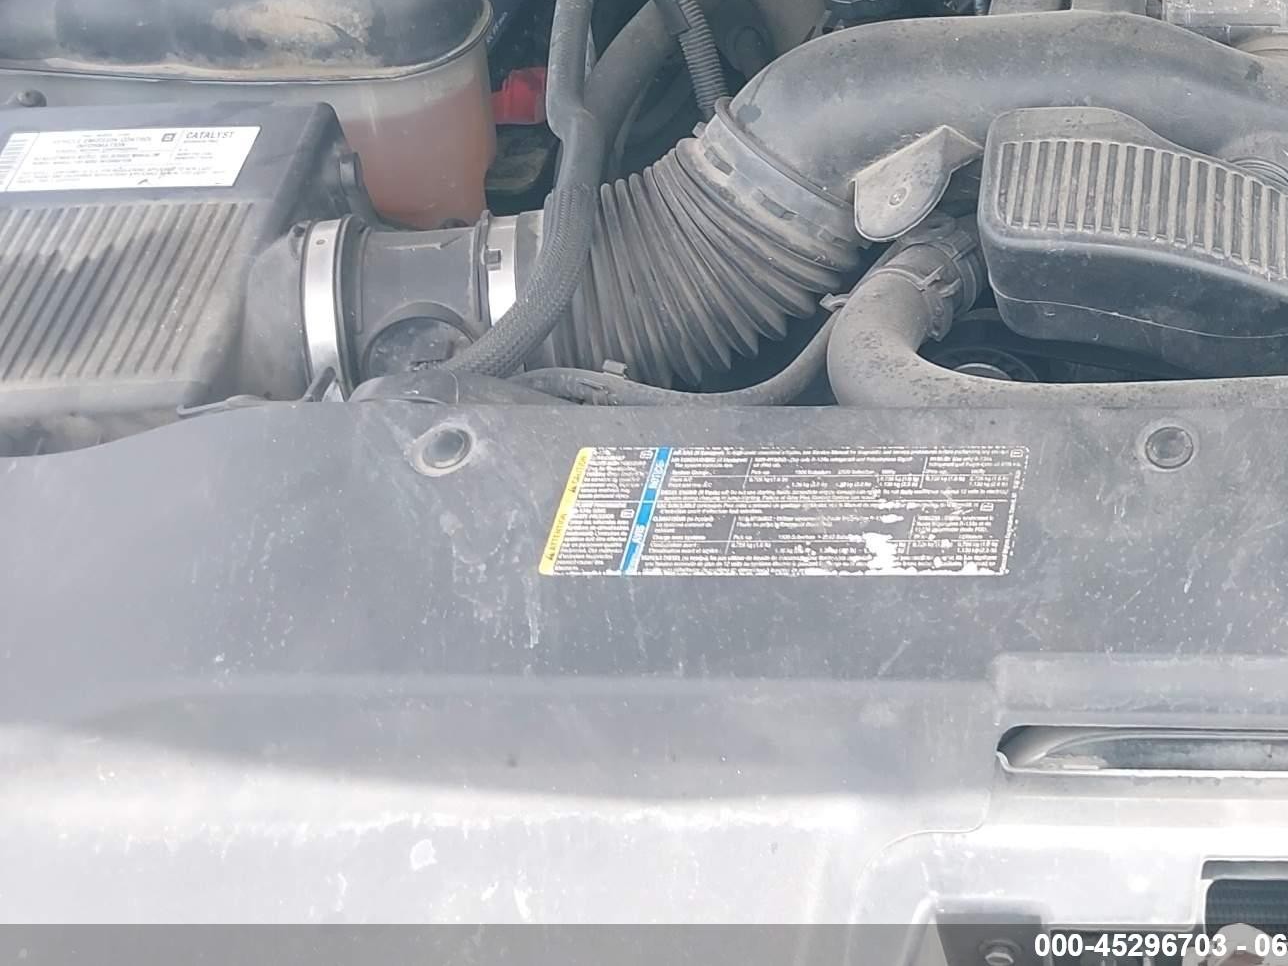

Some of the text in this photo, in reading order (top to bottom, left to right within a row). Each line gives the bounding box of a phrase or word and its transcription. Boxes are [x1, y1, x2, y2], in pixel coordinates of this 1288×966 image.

[186, 131, 235, 139] CATALYST
[572, 456, 587, 484] CAUTION
[649, 459, 666, 488] NOTICE
[549, 513, 567, 552] ATTENTION
